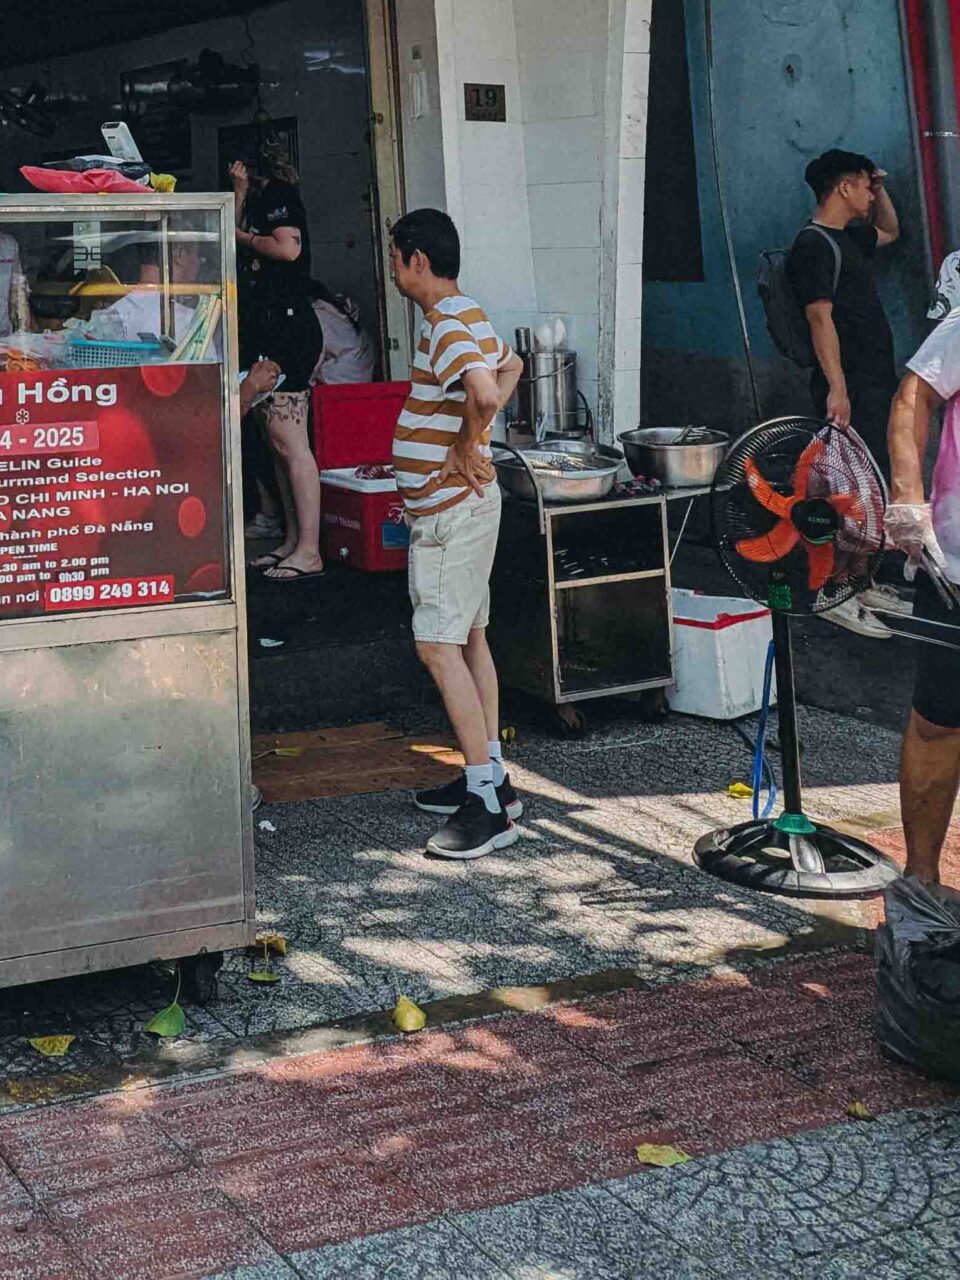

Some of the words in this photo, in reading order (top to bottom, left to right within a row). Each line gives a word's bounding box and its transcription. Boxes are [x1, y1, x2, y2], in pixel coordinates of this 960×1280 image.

[469, 87, 497, 108] 19
[18, 377, 118, 406] Hồng
[33, 427, 84, 448] 2025
[47, 456, 102, 469] Guide
[76, 469, 161, 486] Selection
[16, 493, 49, 504] CHI
[56, 489, 105, 502] MINH
[124, 486, 151, 497] HA
[156, 483, 189, 495] NOI
[12, 507, 71, 521] NANG
[47, 525, 79, 538] phố
[84, 524, 106, 535] Đà
[28, 542, 58, 553] TIME
[22, 562, 41, 571] am
[45, 559, 57, 569] to
[60, 557, 87, 568] 2.00
[90, 556, 110, 566] pm
[17, 573, 36, 584] pm
[39, 571, 51, 580] to
[58, 571, 85, 583] 9h30
[90, 566, 110, 577] pm
[50, 585, 95, 603] 0899
[99, 582, 133, 600] 249
[138, 580, 170, 597] 314
